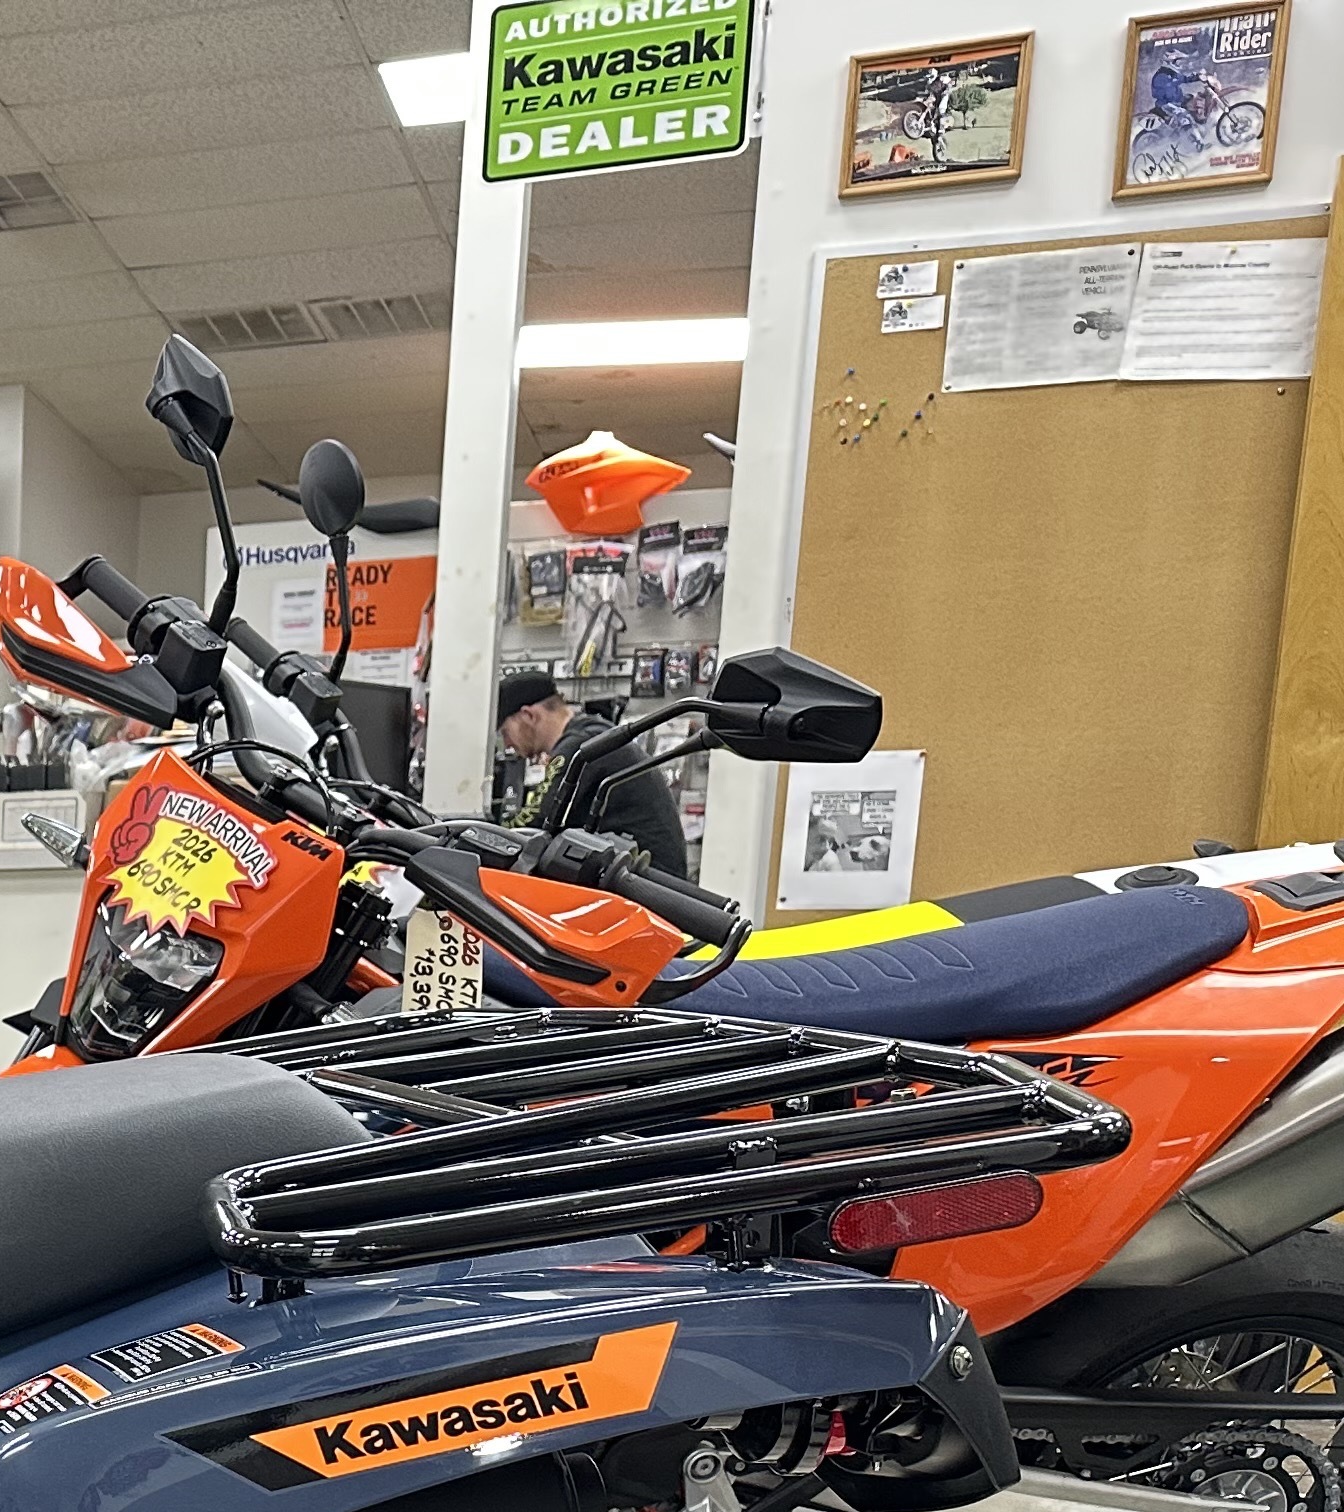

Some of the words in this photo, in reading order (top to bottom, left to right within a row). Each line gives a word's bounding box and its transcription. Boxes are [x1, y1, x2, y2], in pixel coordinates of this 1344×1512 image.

[503, 23, 736, 92] Kawasaki
[1219, 30, 1271, 53] Rider
[501, 87, 597, 116] TEAM
[609, 68, 733, 101] GREEN
[497, 104, 731, 164] DEALER
[327, 563, 393, 587] RADY
[163, 794, 211, 824] NEW
[206, 811, 274, 884] ARRIVAL
[172, 829, 213, 864] 2026
[281, 829, 334, 861] KTM
[159, 847, 196, 877] KTM
[127, 858, 160, 888] 690
[153, 877, 186, 908] SMC
[439, 933, 459, 967] 690
[313, 1372, 591, 1466] Kawasaki
